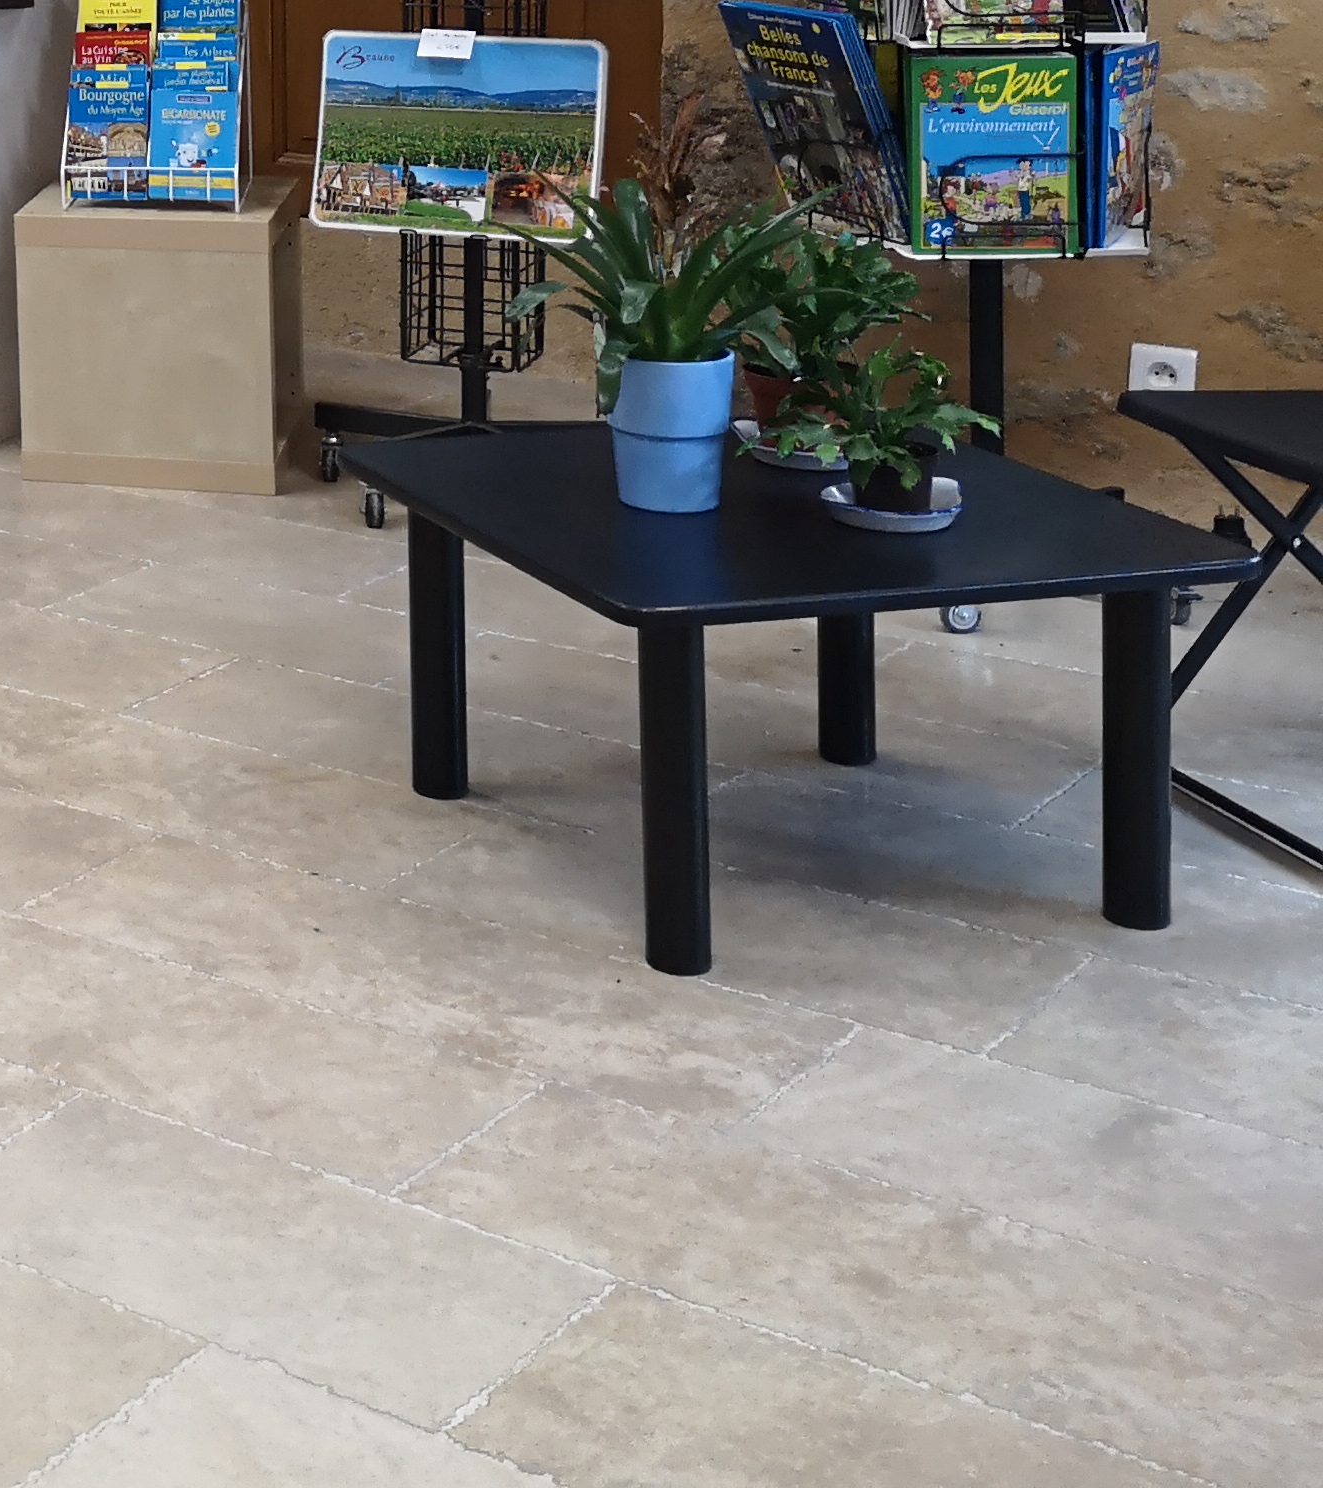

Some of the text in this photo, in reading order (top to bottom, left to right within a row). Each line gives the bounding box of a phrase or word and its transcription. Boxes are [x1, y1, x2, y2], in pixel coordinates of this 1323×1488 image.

[163, 6, 235, 23] par les plantes
[759, 24, 802, 45] Belles
[185, 45, 233, 57] les Arbres
[747, 42, 830, 68] chansons de
[770, 61, 818, 83] France
[79, 88, 145, 104] Bourgogne
[974, 62, 1069, 114] Les Jeux
[161, 108, 226, 121] BICARBONATE
[1009, 103, 1068, 116] Gisserot
[928, 117, 1057, 134] L'environnement
